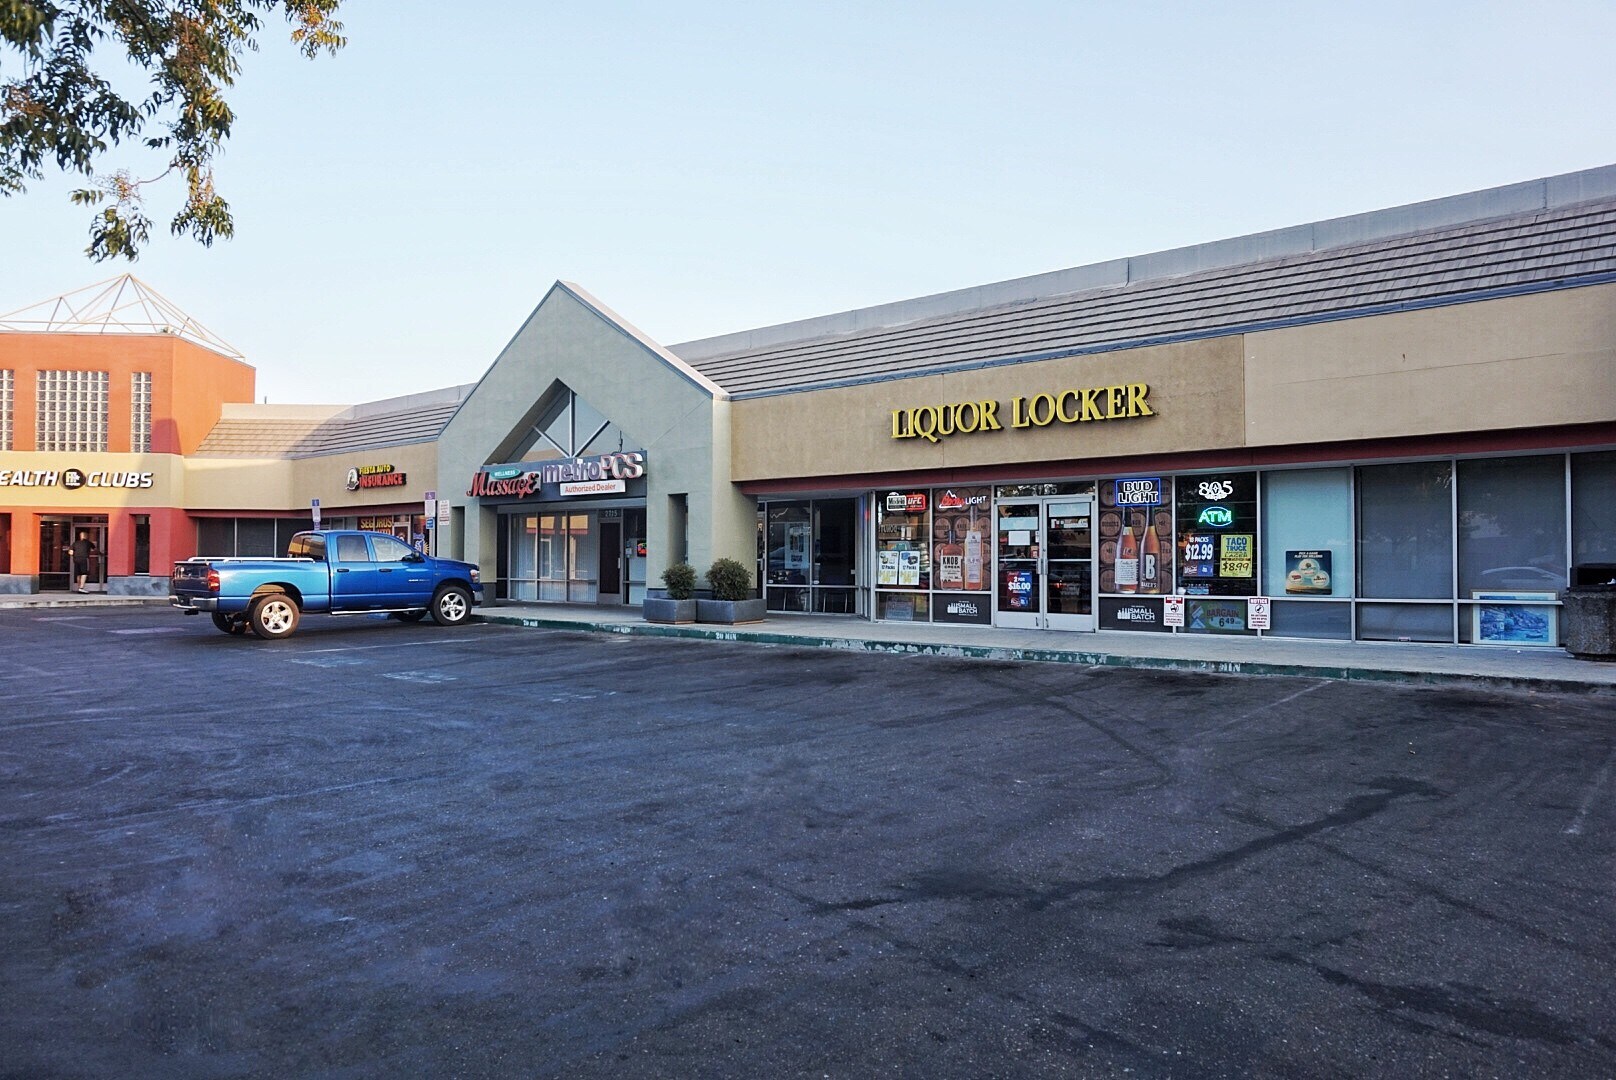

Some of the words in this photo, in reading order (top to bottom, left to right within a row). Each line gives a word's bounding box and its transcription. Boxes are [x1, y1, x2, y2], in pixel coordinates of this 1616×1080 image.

[891, 399, 1001, 442] LIQUOR
[1011, 383, 1153, 428] LOCKER
[359, 465, 376, 475] FIESTA
[377, 464, 391, 473] AUTO
[494, 469, 516, 478] WELLNESS
[543, 453, 643, 483] metroPCS
[0, 470, 59, 486] EALTH
[88, 472, 153, 488] CLUBS
[359, 473, 403, 488] INSURANCE
[564, 484, 597, 493] Authorized
[596, 483, 617, 492] Dealer
[1124, 481, 1152, 492] BUD
[1199, 481, 1233, 496] 805
[907, 496, 922, 505] UFC
[965, 495, 987, 505] LIGHT
[1118, 491, 1158, 503] LIGHT
[1199, 510, 1232, 523] ATM
[1226, 537, 1247, 546] TACO
[1185, 543, 1213, 561] $12.99
[943, 556, 959, 565] KNOB
[1146, 554, 1155, 580] B
[1222, 561, 1249, 572] $8.99
[1207, 608, 1238, 617] BARGAIN
[1219, 663, 1240, 672] MIN
